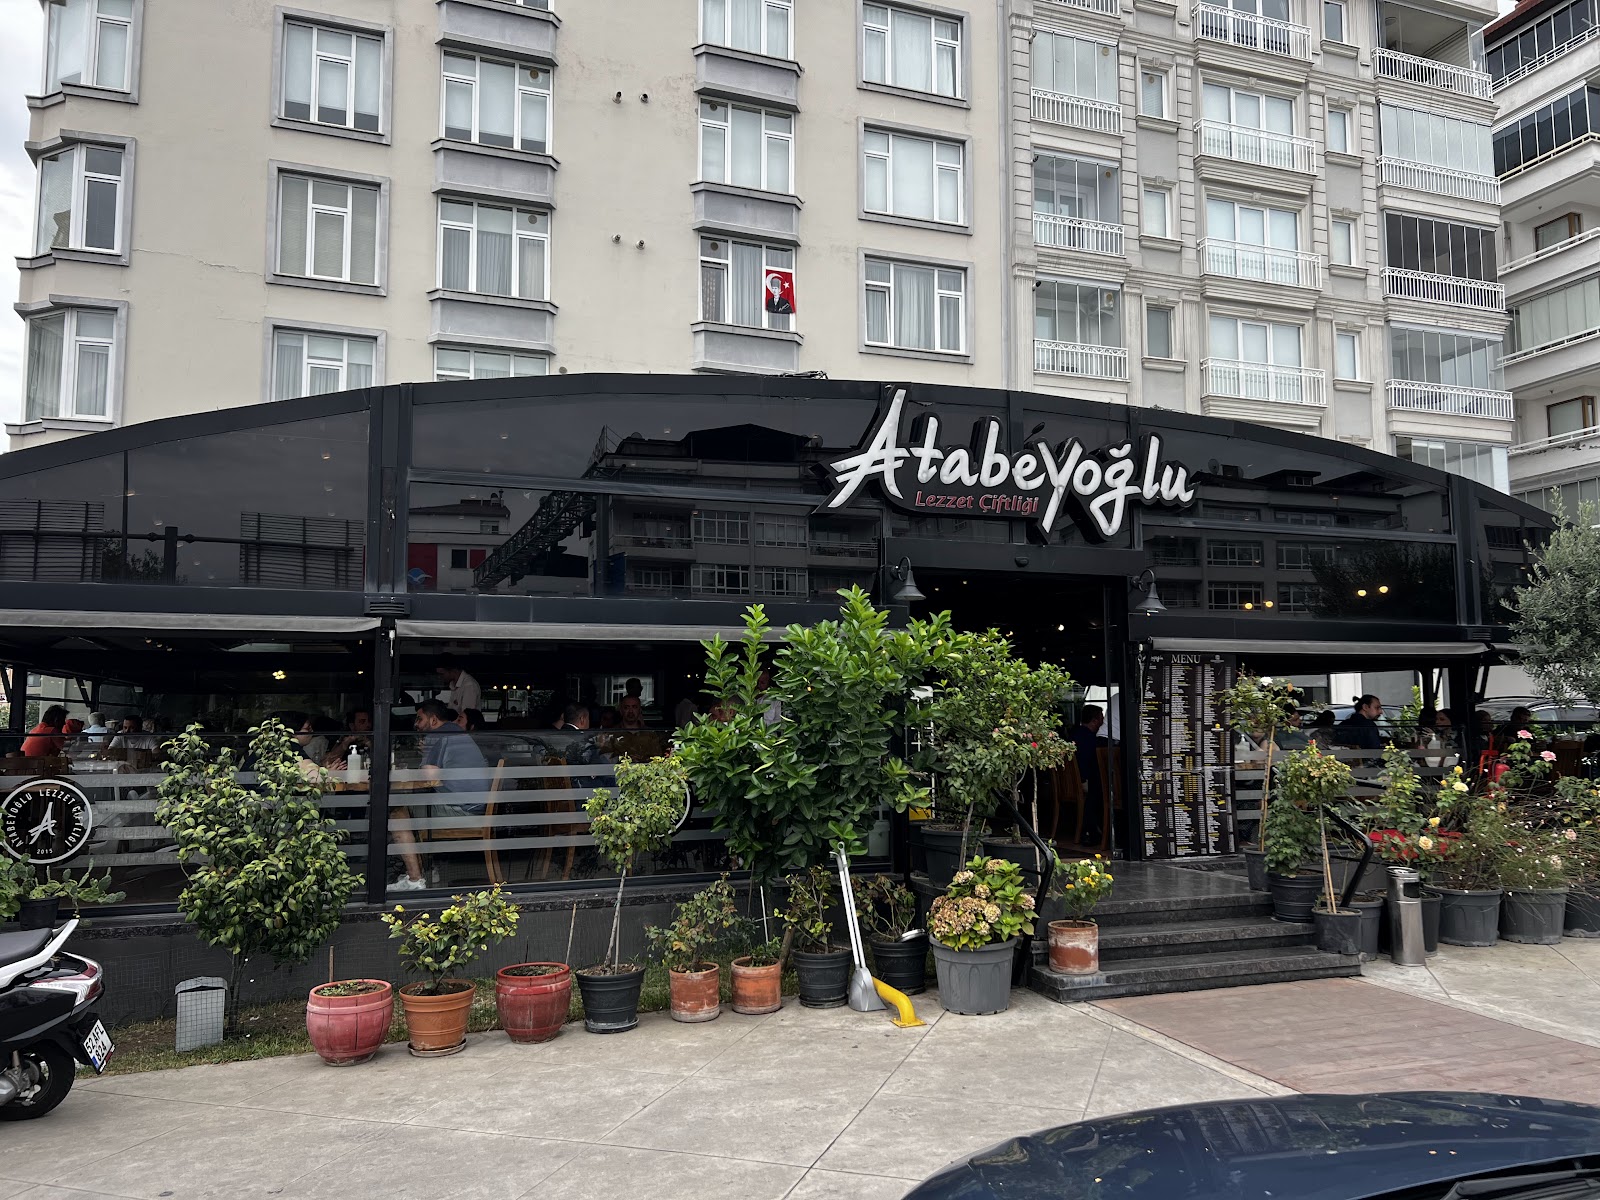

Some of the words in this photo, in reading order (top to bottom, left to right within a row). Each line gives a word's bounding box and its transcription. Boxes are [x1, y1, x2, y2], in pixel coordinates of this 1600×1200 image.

[915, 490, 974, 510] Lezzet
[979, 493, 1040, 516] Çiftliği
[1171, 654, 1201, 664] MENU
[6, 792, 33, 848] ATABEYOĞLU
[39, 788, 76, 805] LEZZET
[85, 1037, 96, 1054] 52
[92, 1024, 104, 1044] AFL
[95, 1040, 107, 1061] 824
